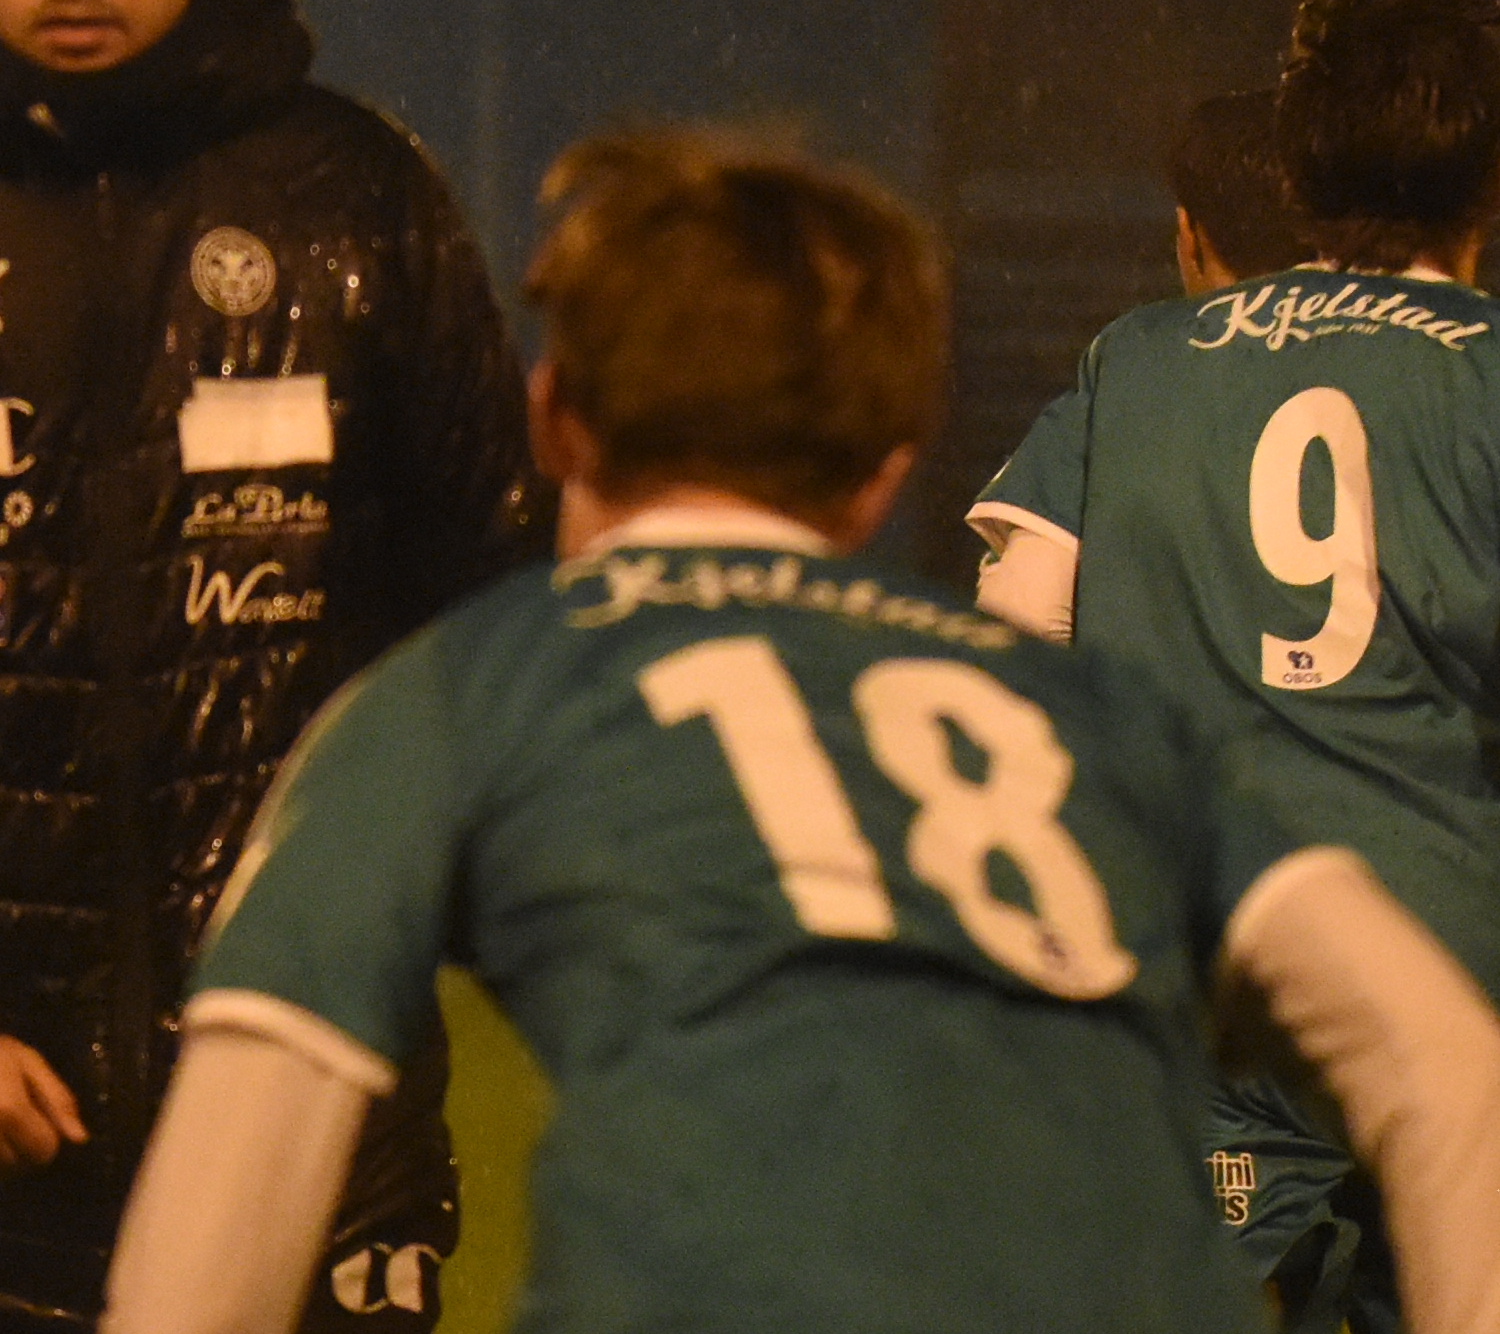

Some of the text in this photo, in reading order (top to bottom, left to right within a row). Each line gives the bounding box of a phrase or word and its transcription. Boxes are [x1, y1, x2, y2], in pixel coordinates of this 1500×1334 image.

[1187, 281, 1490, 352] Kjelstad
[1249, 386, 1380, 690] 9
[1283, 672, 1322, 684] OBOS
[637, 635, 1139, 1002] 18
[1203, 1150, 1256, 1190] ini
